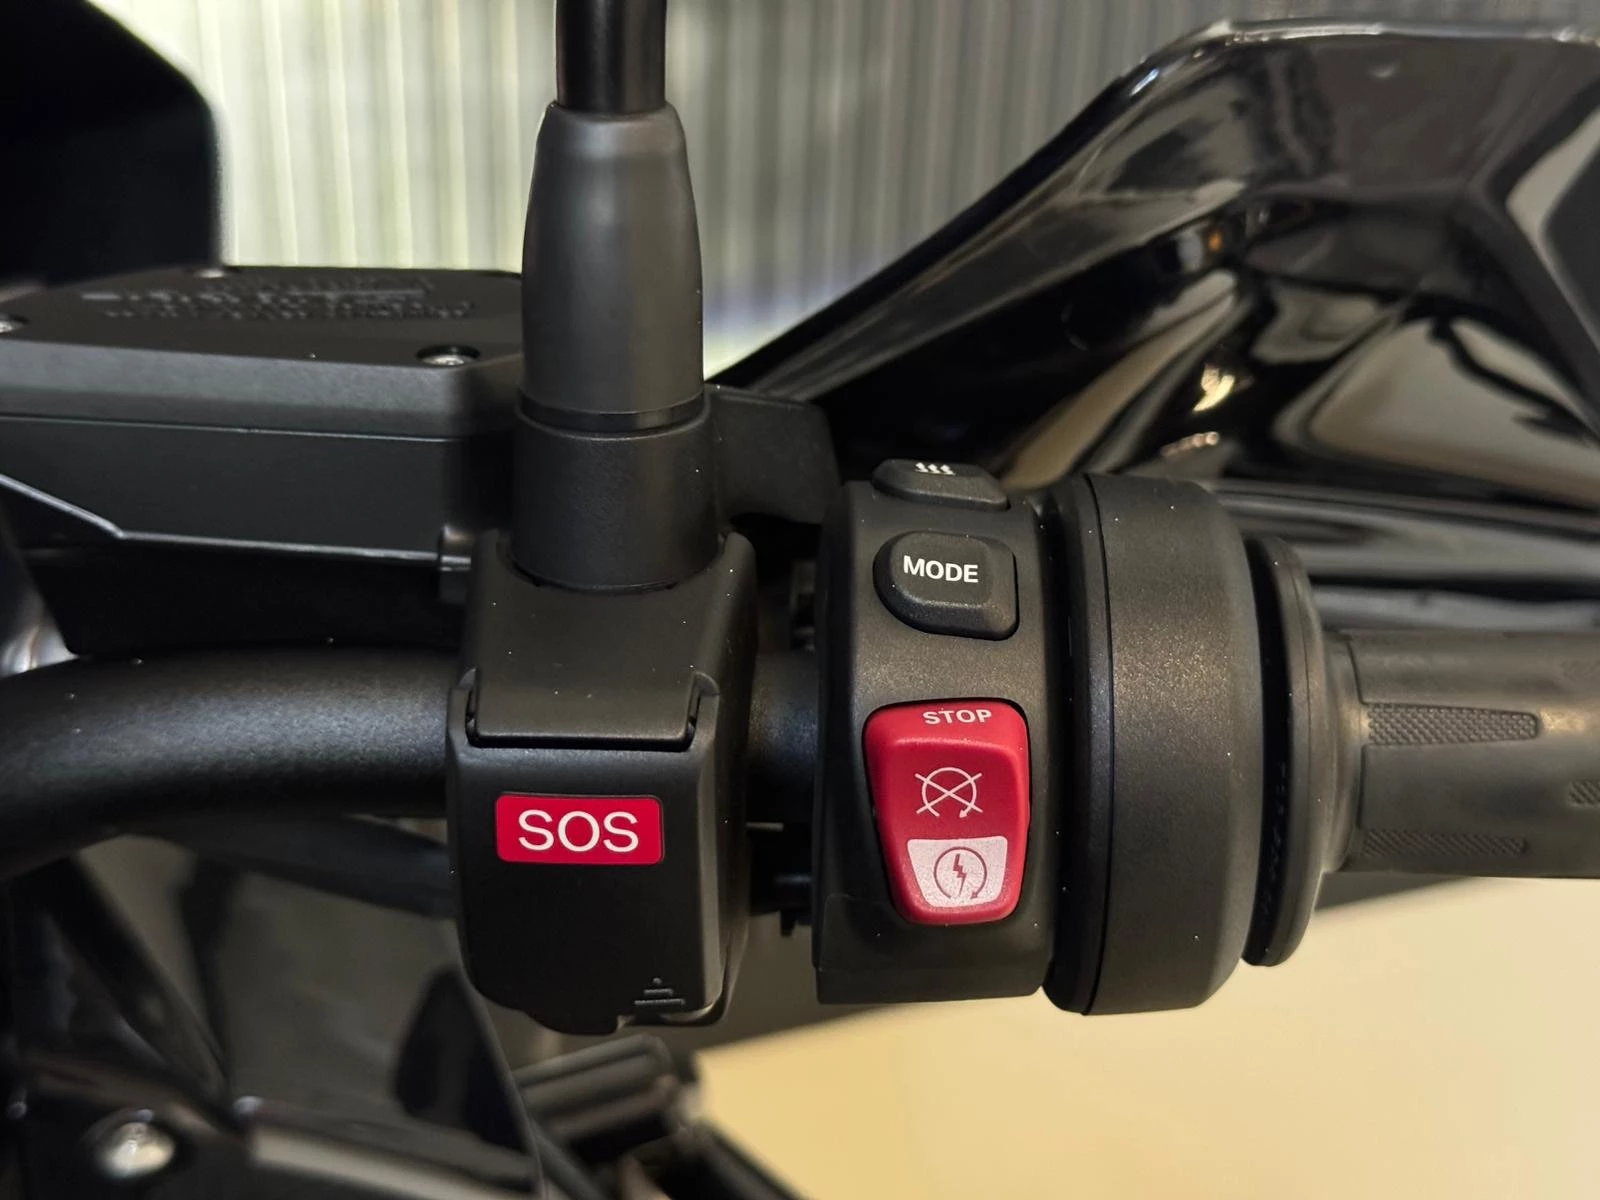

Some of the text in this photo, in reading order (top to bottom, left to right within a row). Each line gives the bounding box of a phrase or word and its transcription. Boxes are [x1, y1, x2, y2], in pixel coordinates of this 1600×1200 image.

[903, 554, 979, 583] MODE
[922, 708, 992, 726] STOP
[518, 809, 639, 853] SOS
